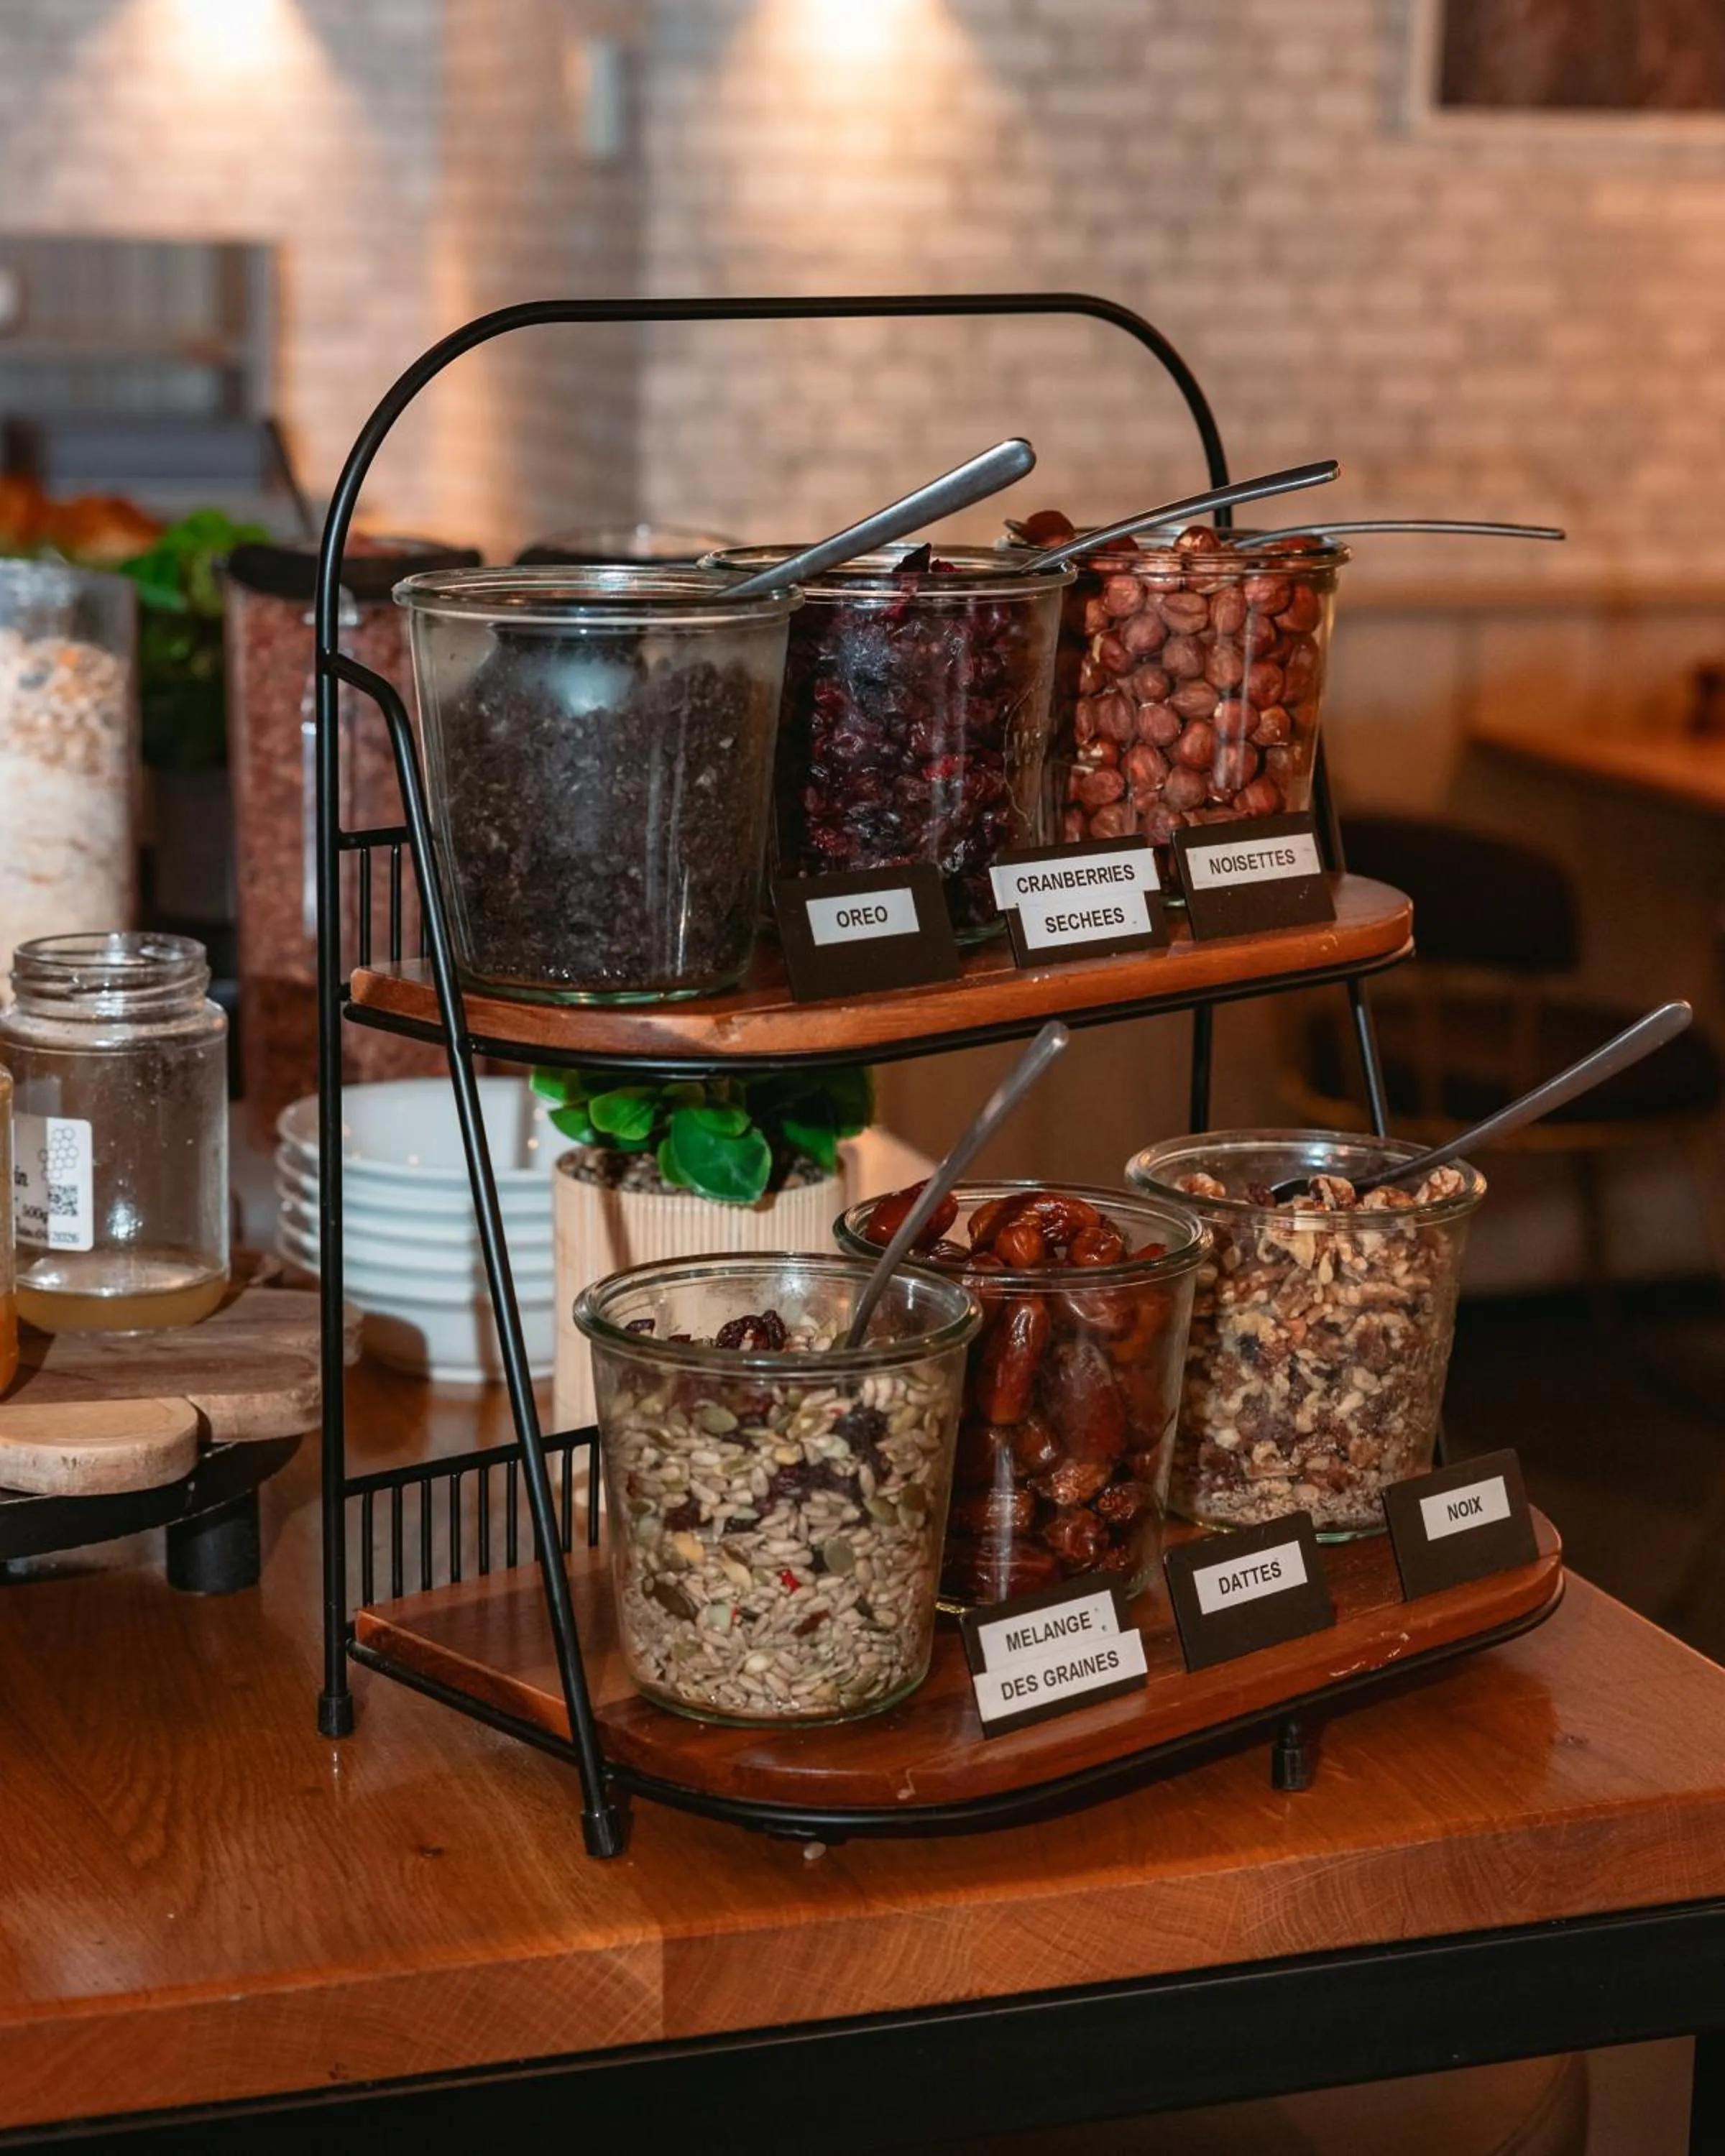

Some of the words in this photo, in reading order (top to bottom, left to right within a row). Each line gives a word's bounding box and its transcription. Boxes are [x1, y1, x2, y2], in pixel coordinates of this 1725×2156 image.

[1209, 849, 1296, 875] NOISETTES
[1016, 864, 1135, 894] CRANBERRIES
[836, 906, 888, 928] OREO
[1044, 907, 1125, 934] SECHEES
[1447, 1496, 1483, 1521] NOIX
[1218, 1561, 1282, 1595] DATTES
[1006, 1611, 1092, 1652] MELANGE
[1000, 1674, 1039, 1700] DES
[1043, 1650, 1119, 1687] GRAINES
